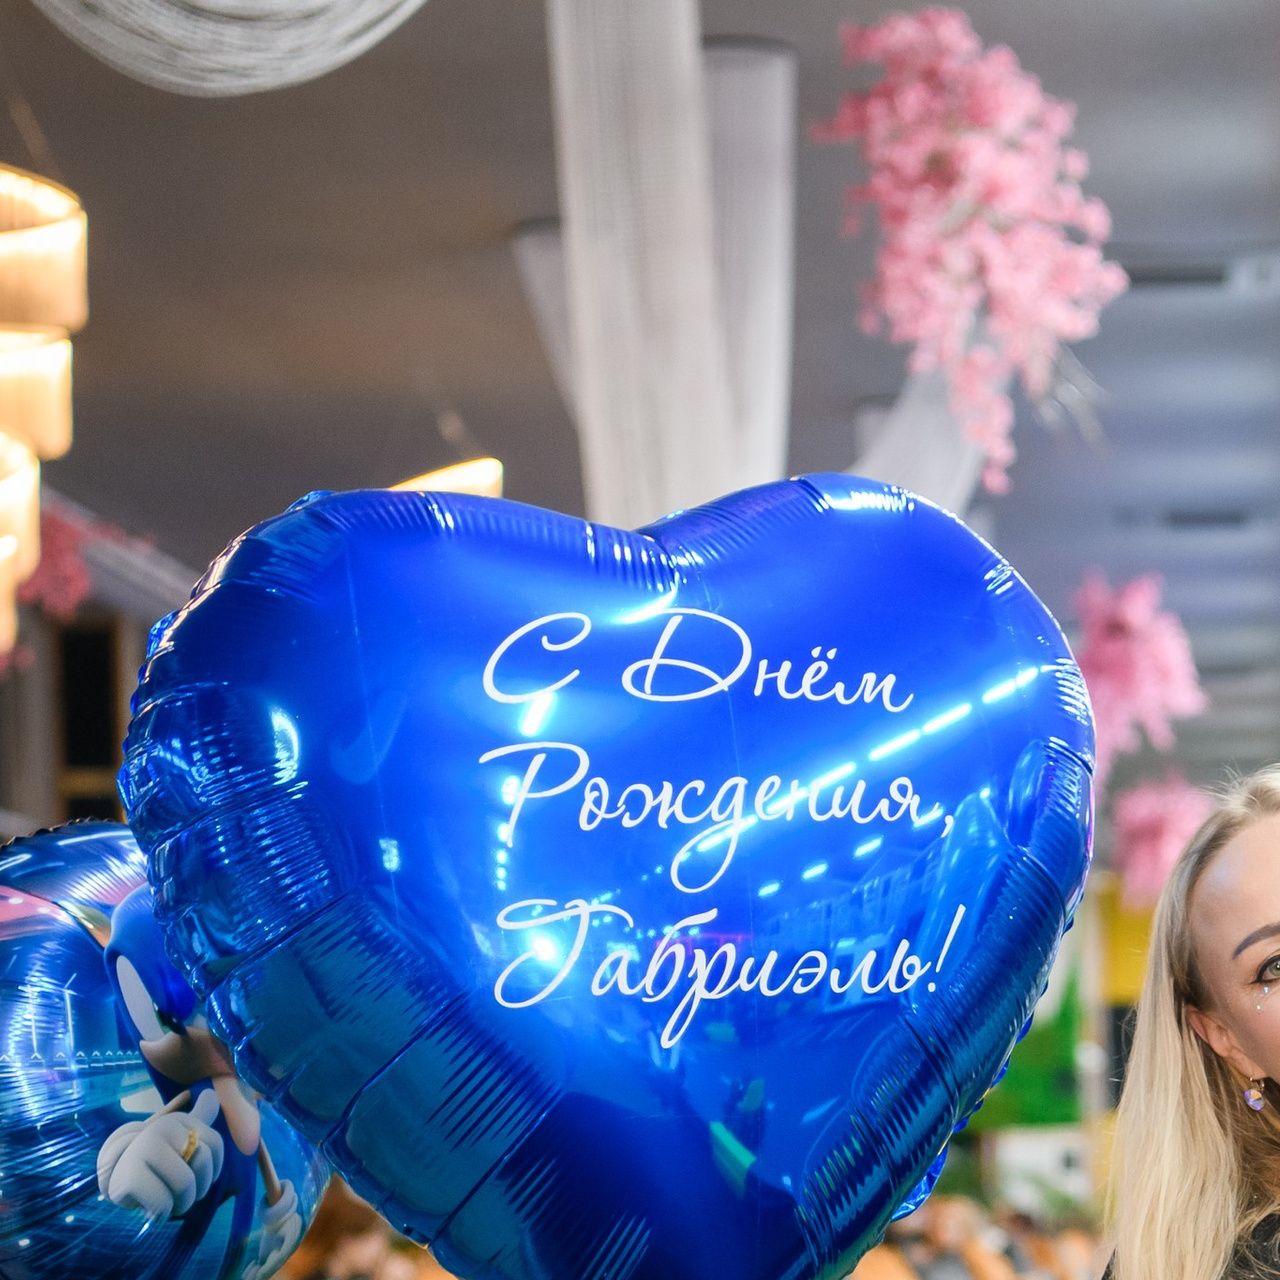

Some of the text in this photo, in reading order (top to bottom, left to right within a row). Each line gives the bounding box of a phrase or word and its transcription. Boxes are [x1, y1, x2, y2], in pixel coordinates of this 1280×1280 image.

[482, 607, 915, 712] С Днём
[478, 741, 955, 893] Рождения,
[494, 898, 966, 1049] Габриэль!
